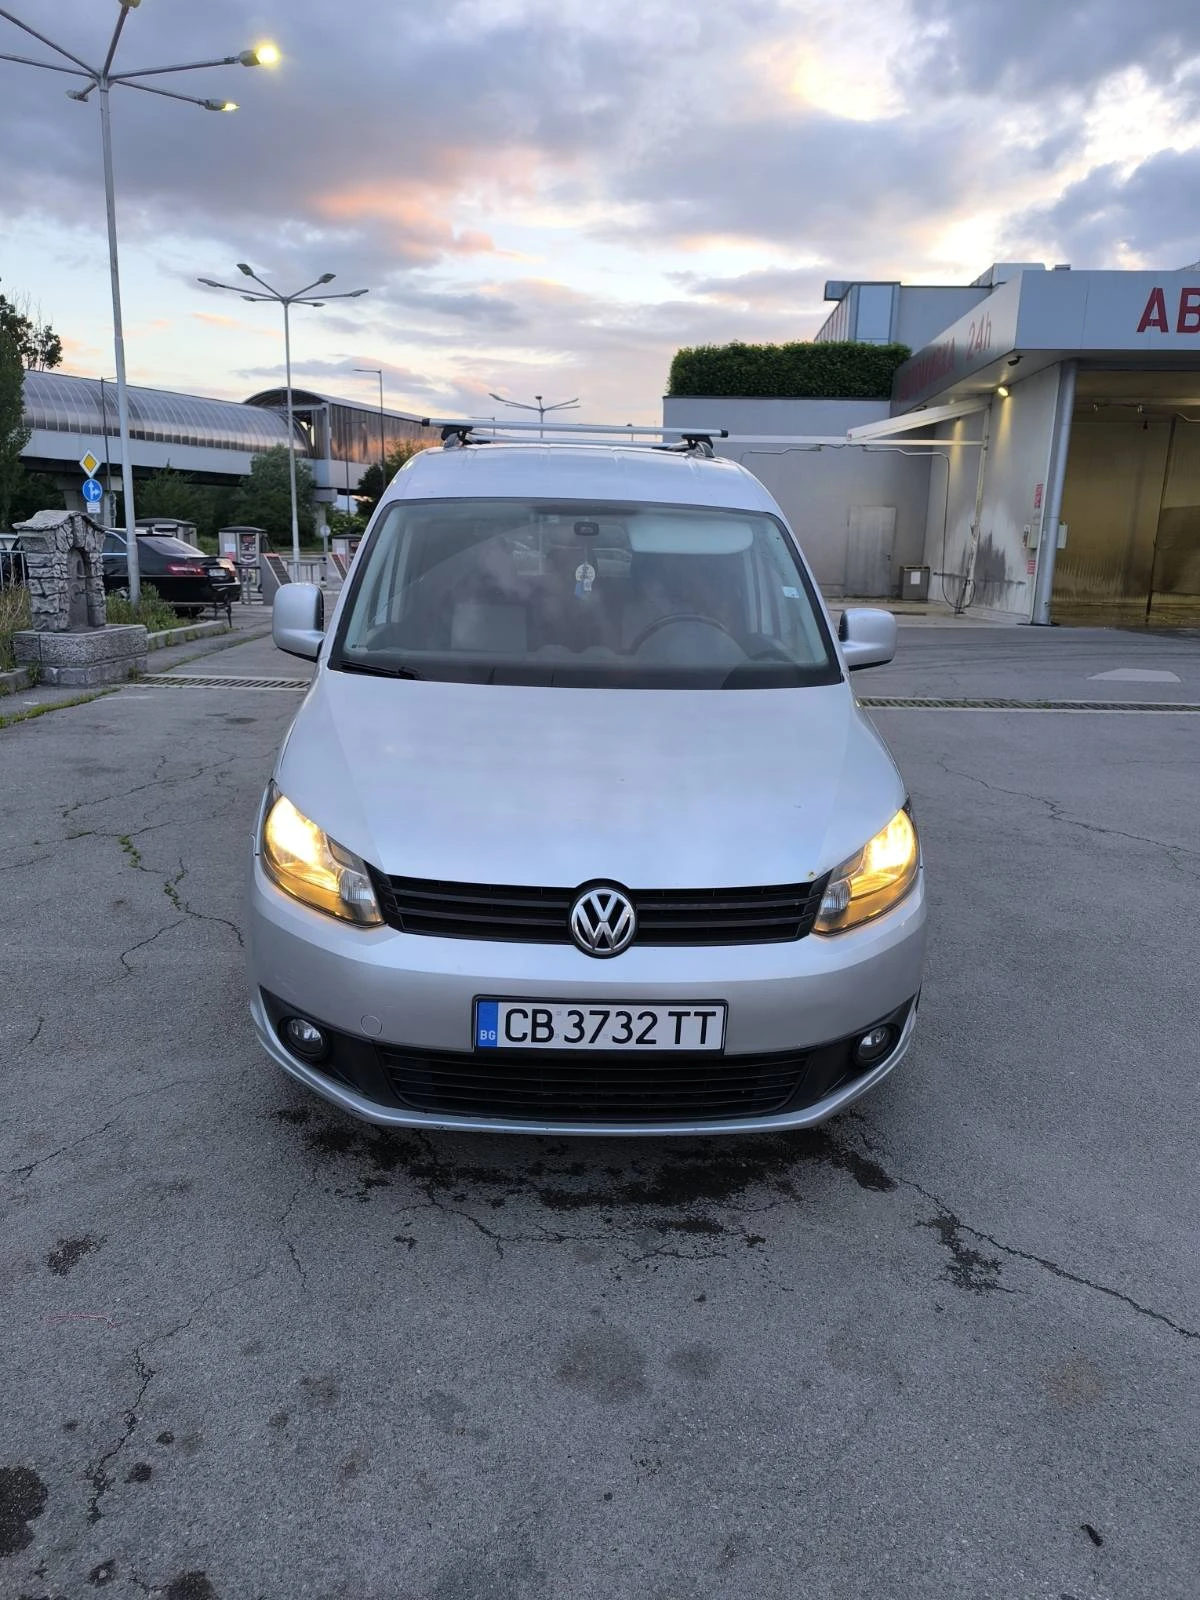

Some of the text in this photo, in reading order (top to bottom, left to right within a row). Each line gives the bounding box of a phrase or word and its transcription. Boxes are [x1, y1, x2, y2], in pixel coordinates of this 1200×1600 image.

[480, 1030, 496, 1040] BG
[505, 1008, 716, 1045] CB 3732 TT
